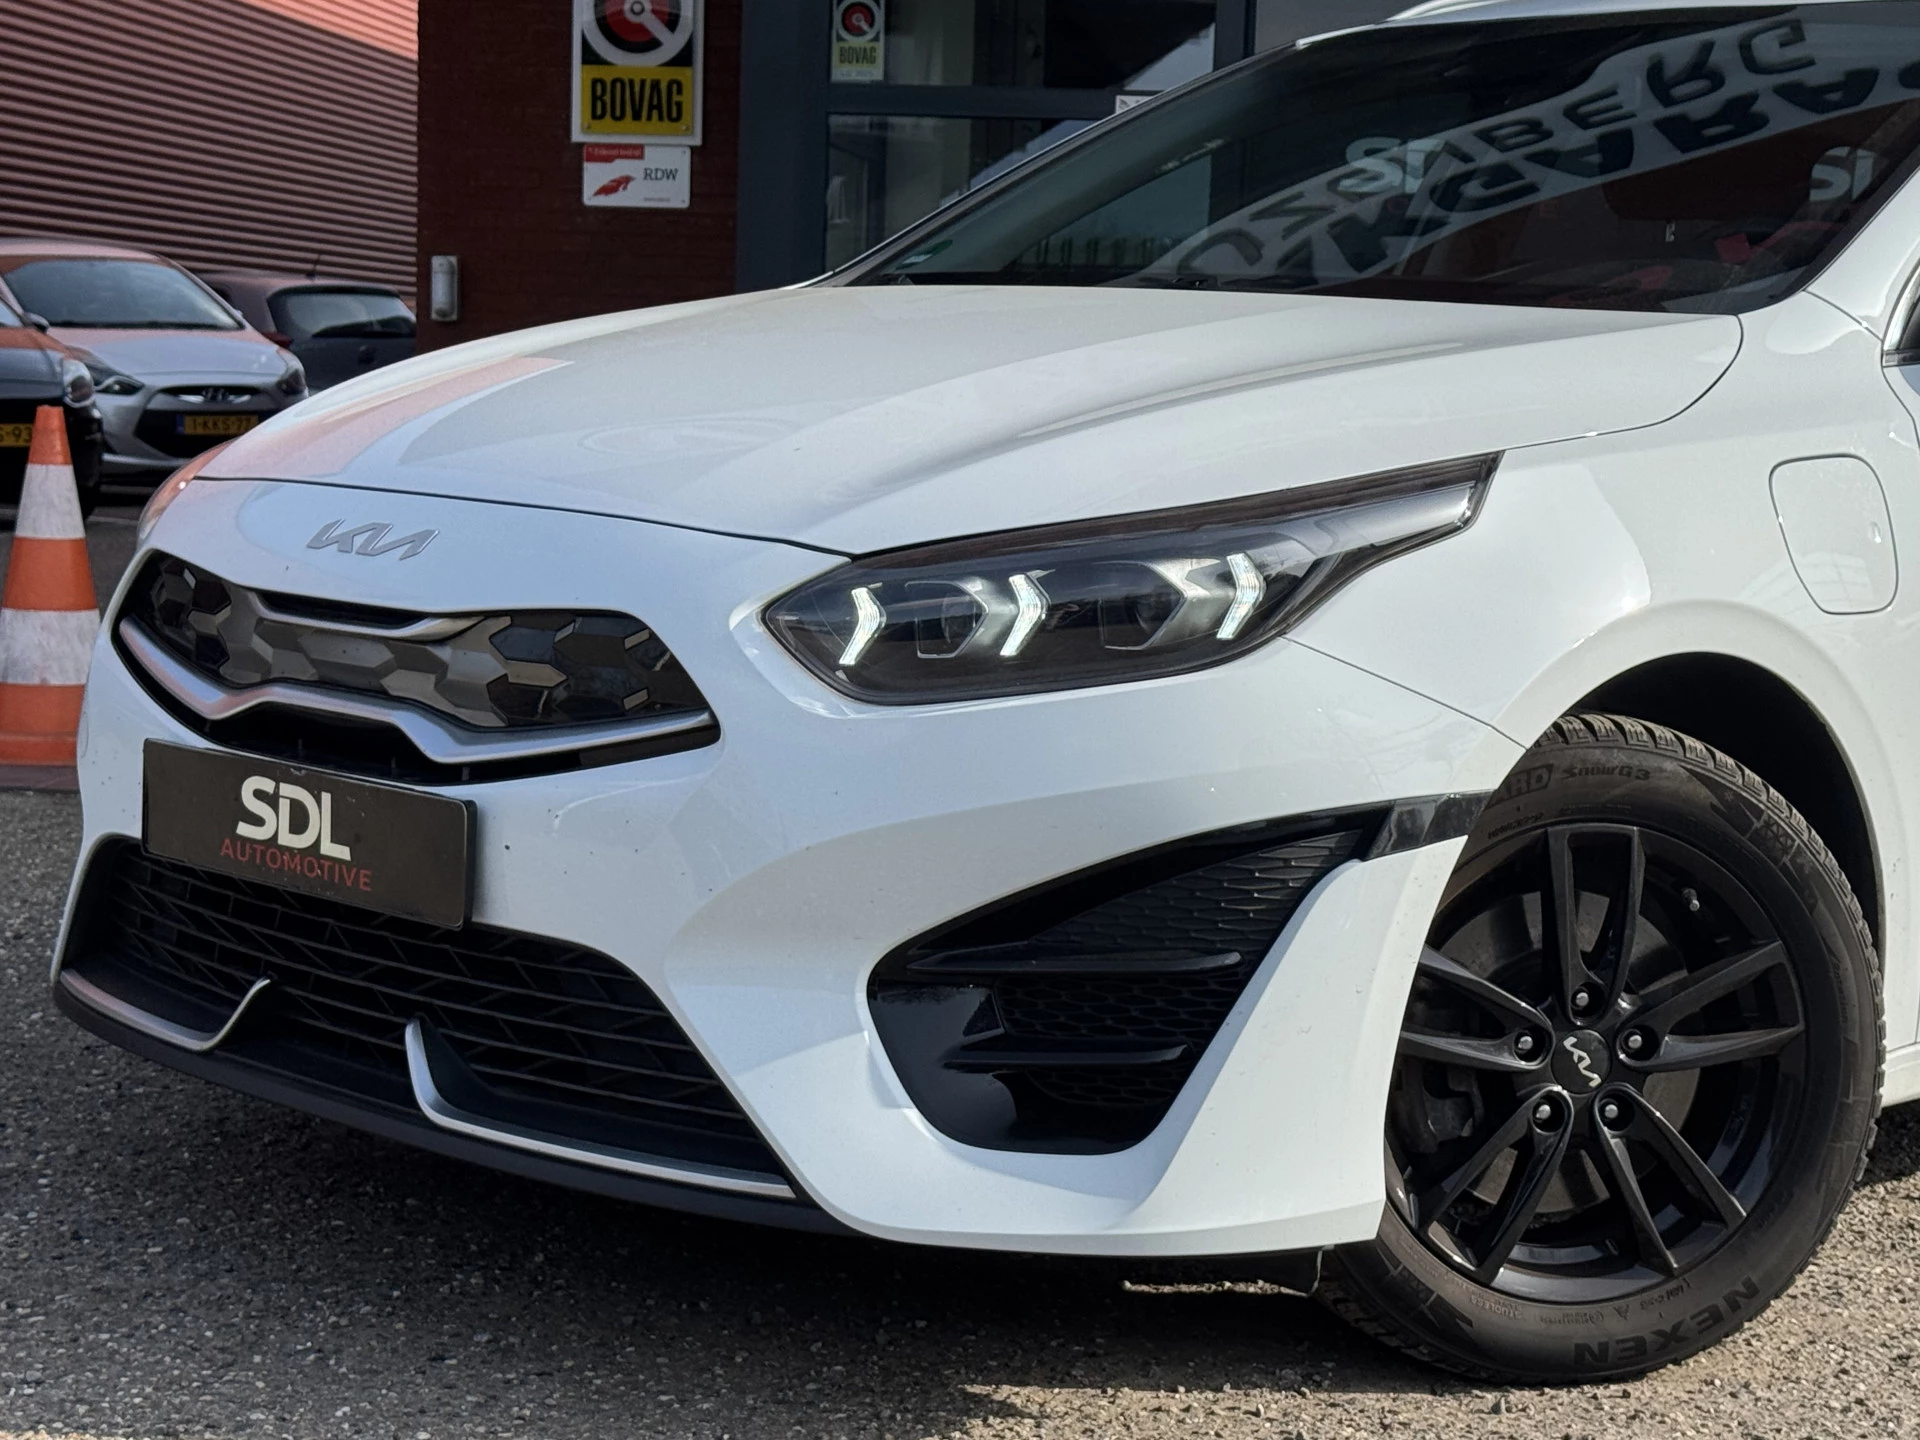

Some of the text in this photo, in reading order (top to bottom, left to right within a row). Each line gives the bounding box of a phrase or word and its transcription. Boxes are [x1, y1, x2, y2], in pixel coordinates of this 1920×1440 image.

[839, 46, 877, 65] BOVAG
[591, 77, 683, 123] BOVAG
[643, 167, 679, 181] RDW
[305, 517, 441, 561] KIA
[236, 774, 352, 861] SDL
[220, 835, 372, 893] AUTOMOTIVE
[1573, 1276, 1760, 1366] NEXEN
